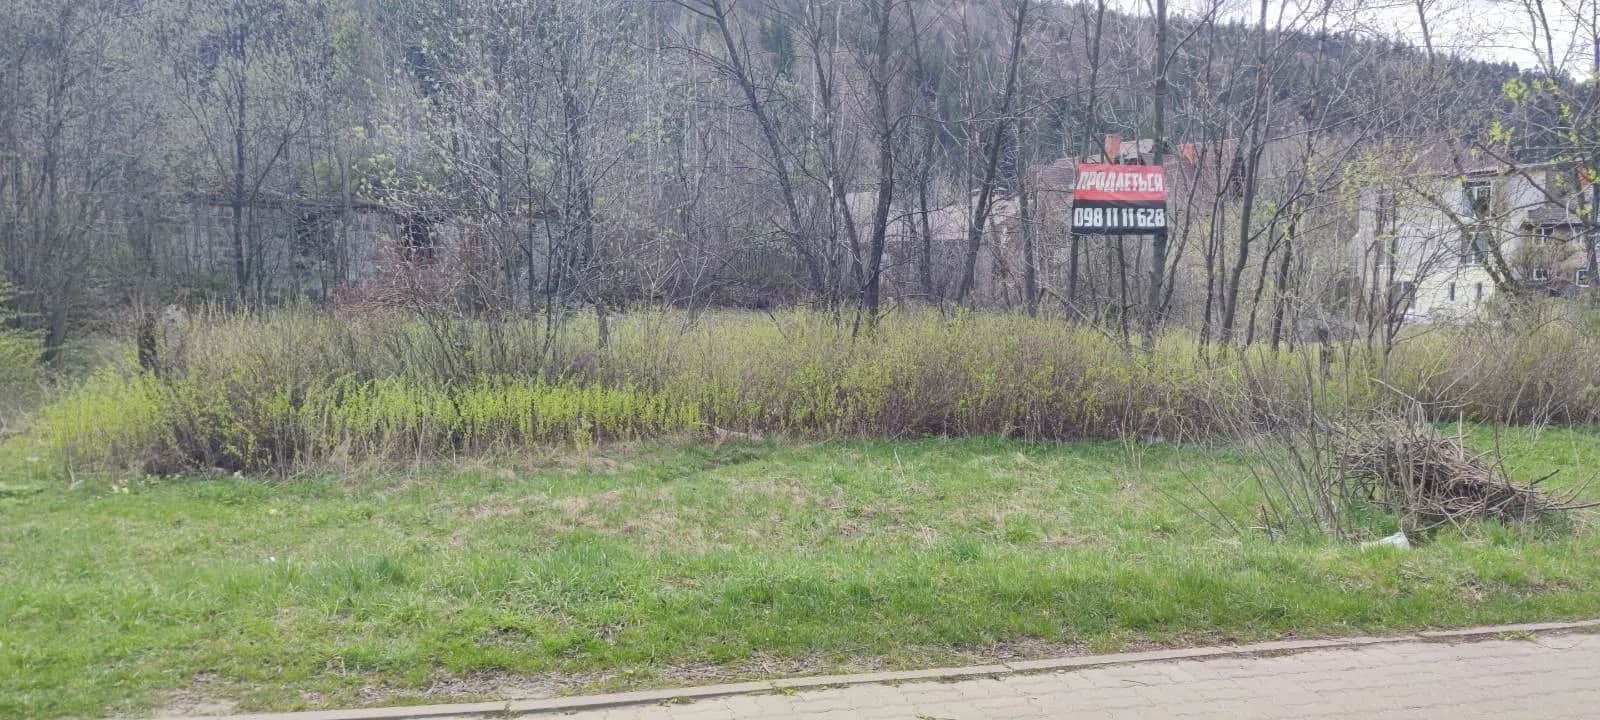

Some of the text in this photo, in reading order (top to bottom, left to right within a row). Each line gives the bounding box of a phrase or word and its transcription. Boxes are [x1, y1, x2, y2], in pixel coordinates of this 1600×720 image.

[1074, 207, 1165, 227] 098 11 11 628
